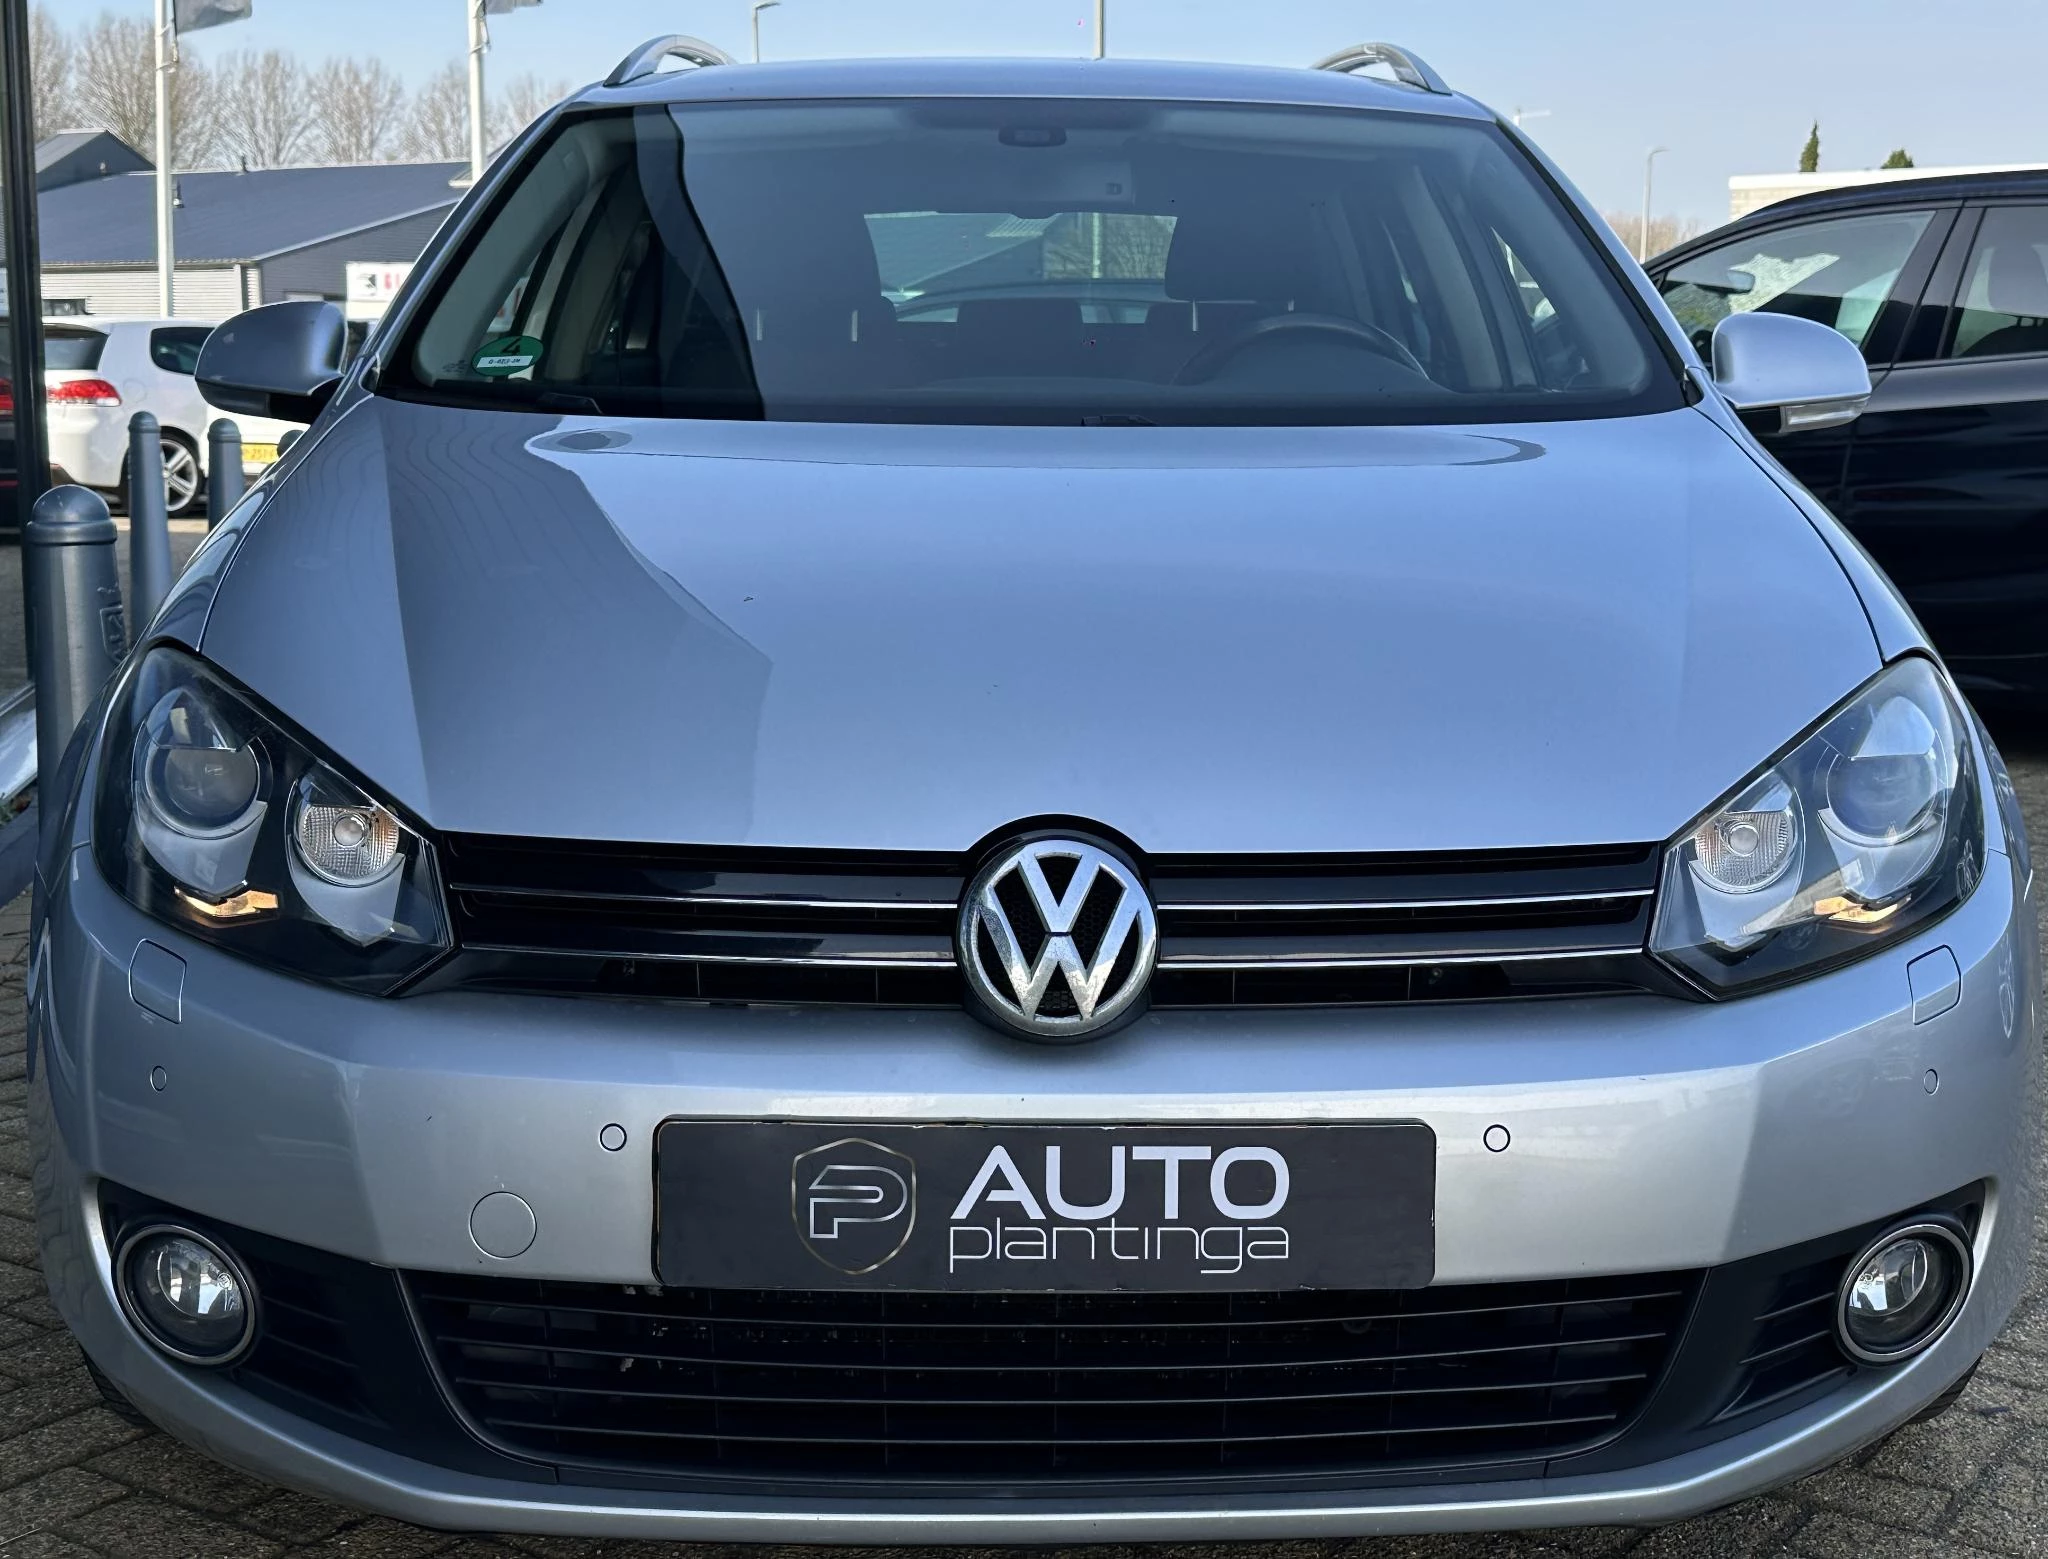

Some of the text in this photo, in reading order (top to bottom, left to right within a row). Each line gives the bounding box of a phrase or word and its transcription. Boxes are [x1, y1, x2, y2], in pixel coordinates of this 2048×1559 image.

[501, 338, 521, 355] 4
[972, 846, 1145, 1024] VW
[950, 1145, 1290, 1220] AUTO
[950, 1219, 1290, 1274] plantinga
